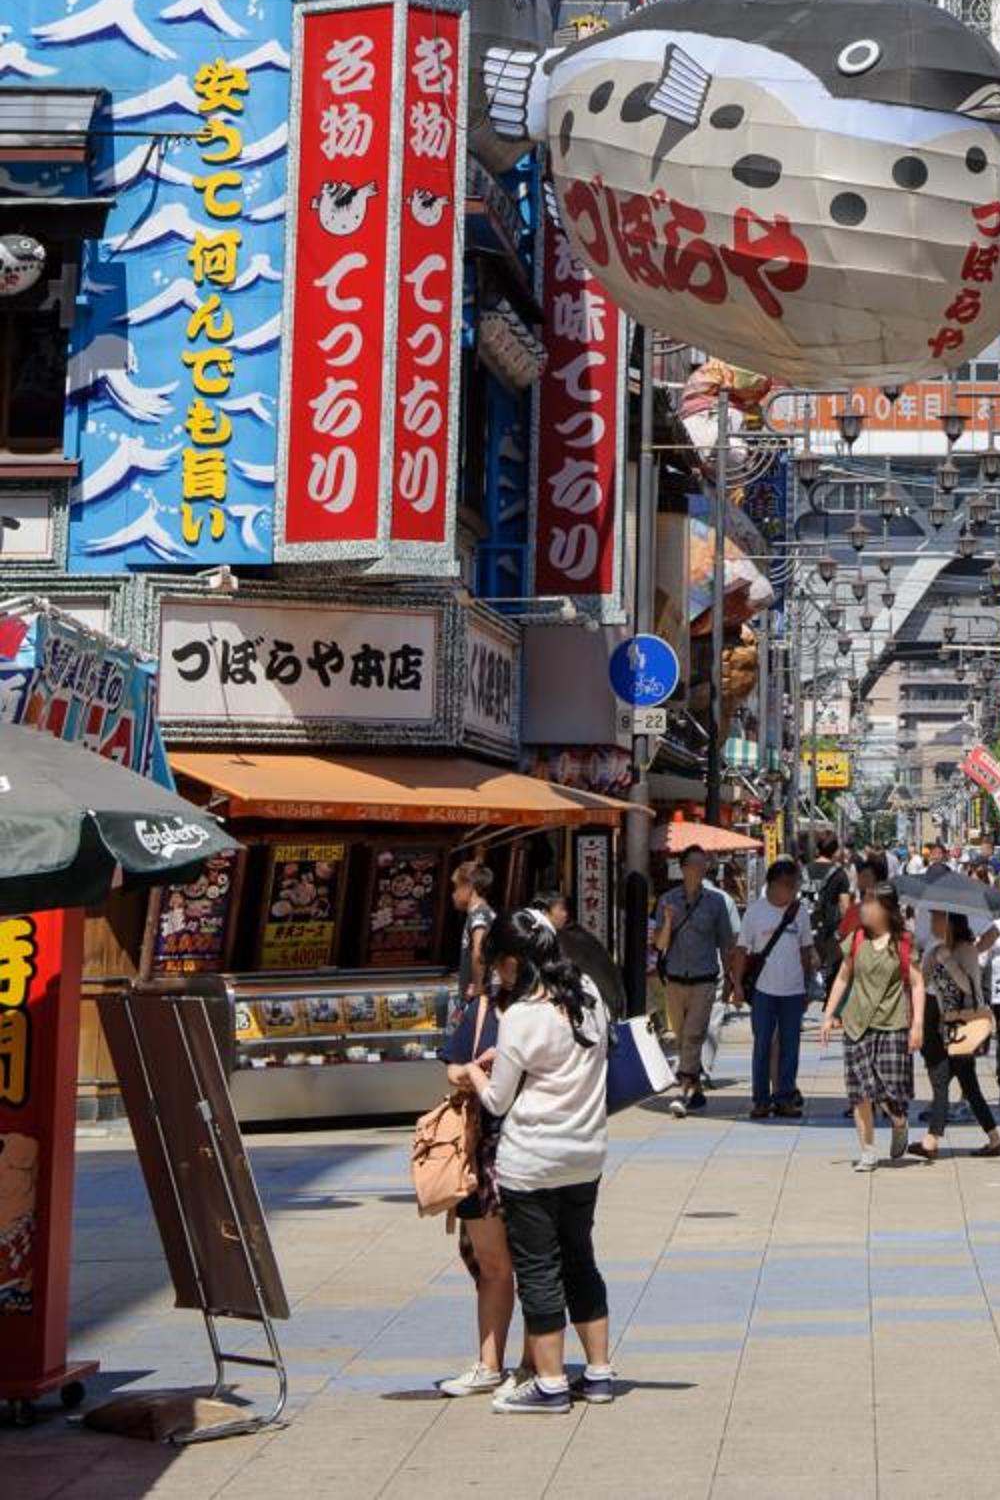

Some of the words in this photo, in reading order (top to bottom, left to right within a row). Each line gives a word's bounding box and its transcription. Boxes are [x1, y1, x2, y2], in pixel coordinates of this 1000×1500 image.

[320, 34, 375, 160] 名物
[409, 36, 453, 160] 名物
[181, 58, 249, 545] 安うて何んでも旨い
[564, 175, 808, 319] づぼらや
[307, 253, 369, 514] てっちり
[398, 253, 449, 514] てっちり
[171, 636, 424, 691] づぼらや本店
